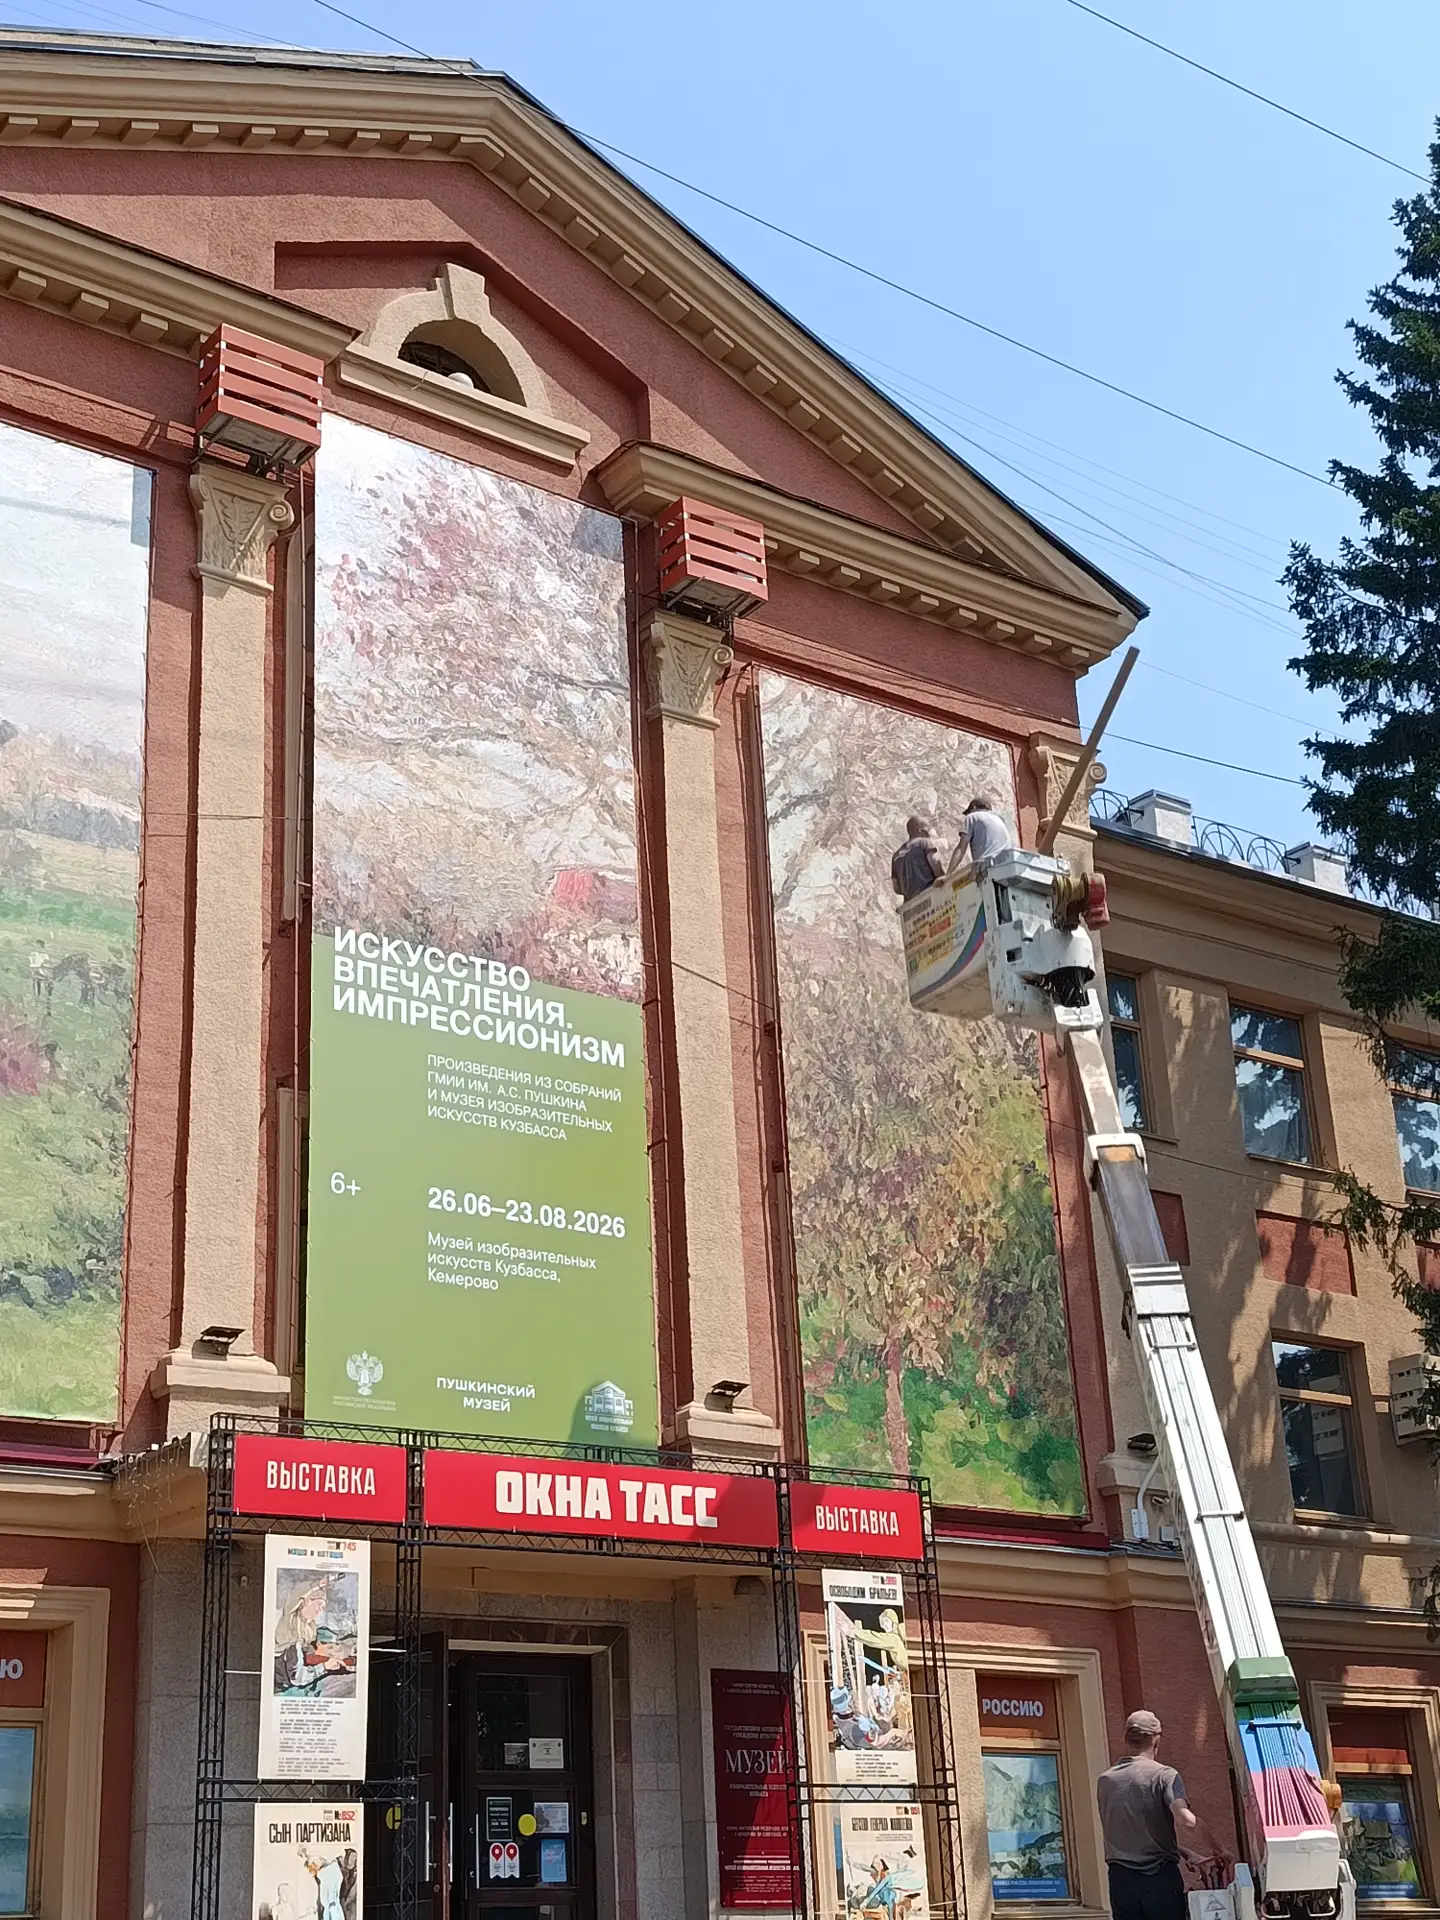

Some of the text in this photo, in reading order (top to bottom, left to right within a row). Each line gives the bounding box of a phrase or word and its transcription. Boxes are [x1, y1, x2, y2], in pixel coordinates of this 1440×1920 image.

[333, 926, 531, 992] ИСКУССТВО
[333, 955, 574, 1029] ВПЕЧАТЛЕНИЯ.
[333, 984, 626, 1068] ИМПРЕССИОНИЗМ
[427, 1053, 622, 1102] ПРОИЗВЕДЕНИЯ ИЗ СОБРАНИЙ
[427, 1071, 587, 1112] ГМИИ ИМ. А.С. ПУШКИНА
[427, 1088, 613, 1133] И МУЗЕЯ ИЗОБРАЗИТЕЛЬНЫХ
[427, 1105, 568, 1140] ИСКУССТВ КУЗБАССА
[330, 1171, 361, 1197] 6+
[427, 1232, 597, 1269] Музей изобразительных
[427, 1253, 562, 1283] искусств Кузбасса,
[427, 1267, 499, 1290] Кемерово
[436, 1377, 536, 1399] ПУШКИНСКИЙ
[463, 1396, 511, 1413] МУЗЕЙ
[266, 1460, 376, 1496] ВЫСТАВКА
[496, 1470, 718, 1528] ОКНА ТАСС
[815, 1504, 900, 1537] ВЫСТАВКА
[982, 1698, 1044, 1718] РОССИЮ
[725, 1745, 790, 1774] МУЗЕЙ
[269, 1823, 351, 1843] СЫН ПАРТИЗАНА
